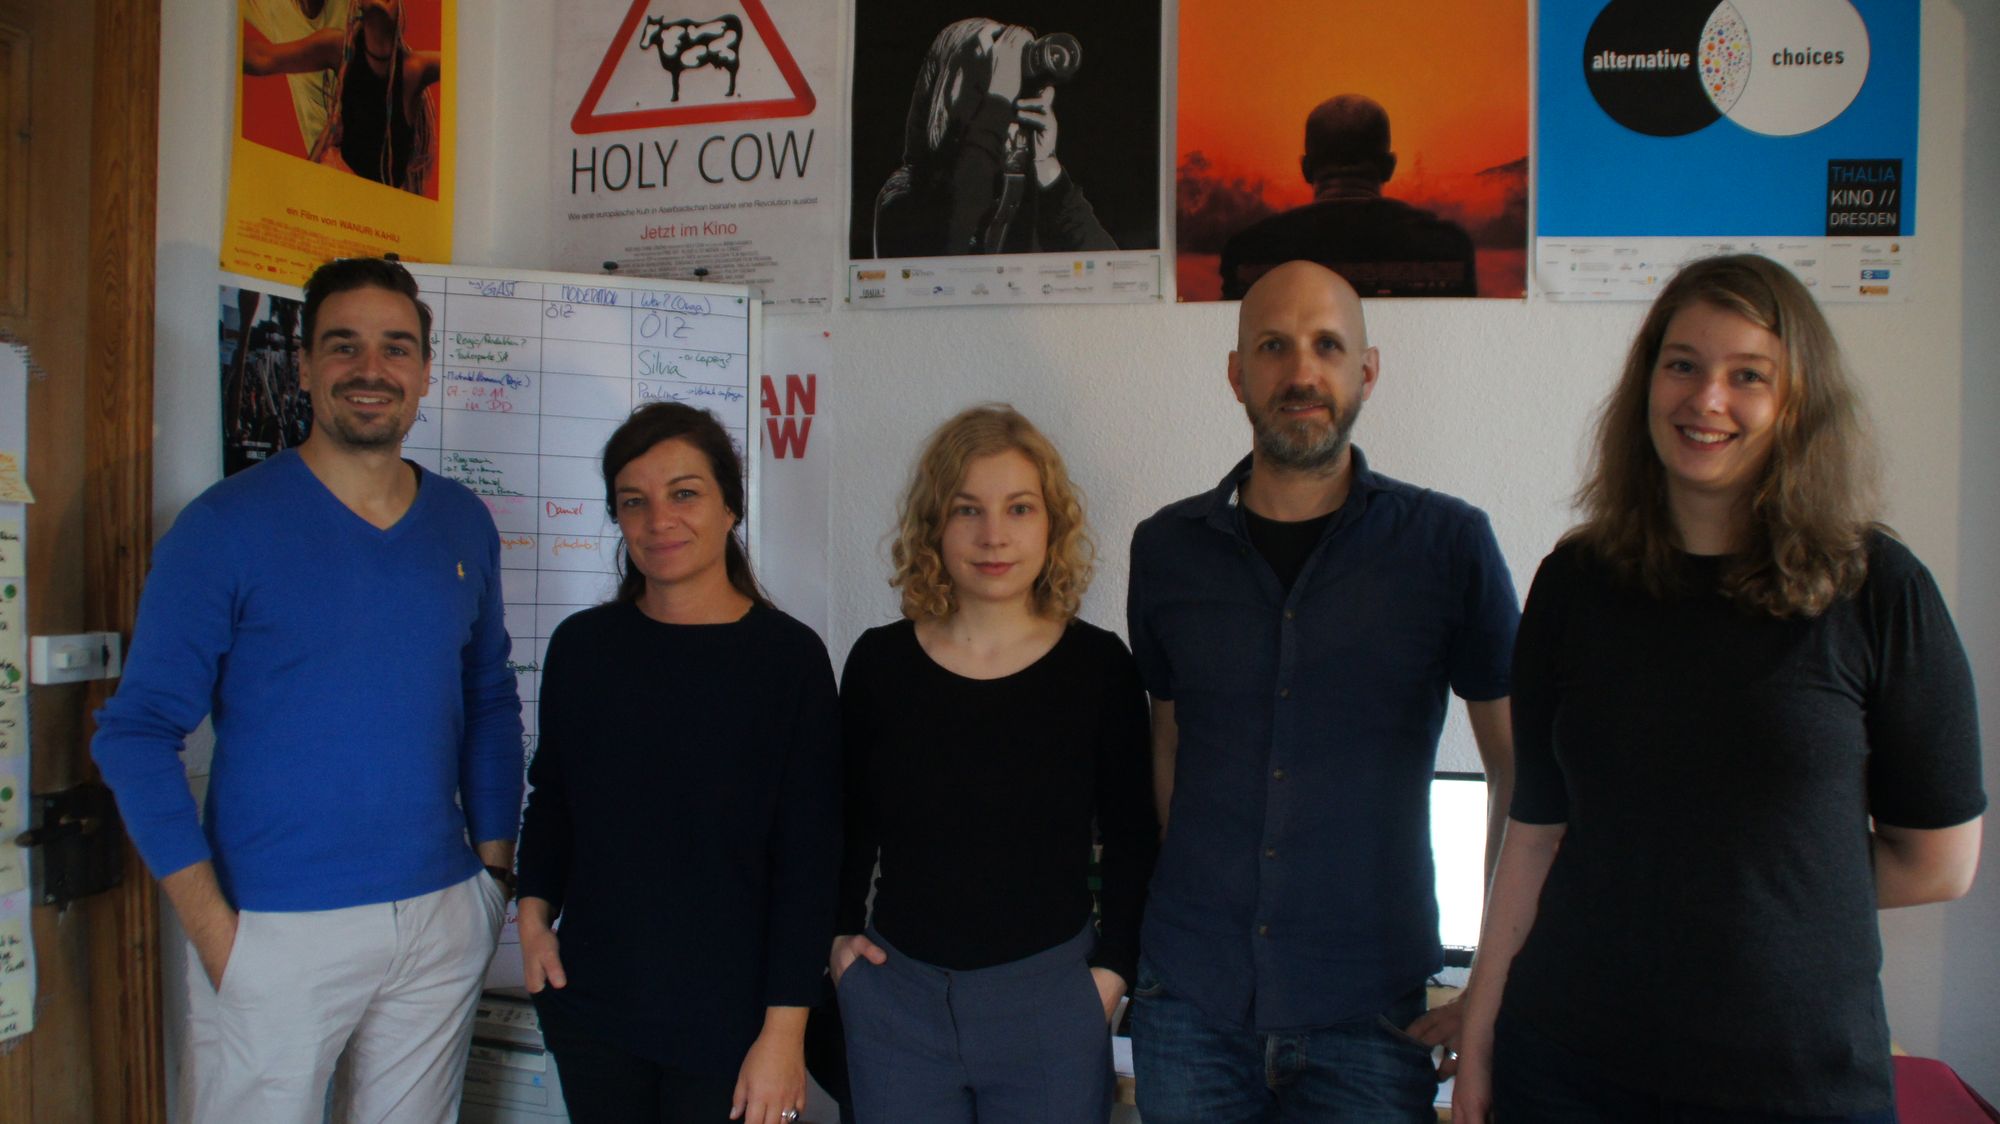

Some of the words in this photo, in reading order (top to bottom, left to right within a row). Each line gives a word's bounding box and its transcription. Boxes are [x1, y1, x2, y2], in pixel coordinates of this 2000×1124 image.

[1592, 48, 1691, 70] alternative
[1772, 47, 1845, 66] choices
[571, 139, 679, 194] HOLY
[698, 128, 815, 184] COW
[1831, 166, 1896, 182] THALIA
[753, 198, 791, 208] Revolution
[1831, 189, 1874, 206] KINO
[286, 207, 299, 216] ein
[300, 209, 319, 222] Film
[320, 217, 337, 226] von
[339, 219, 374, 237] WANURI
[1830, 212, 1897, 226] DRESDEN
[640, 223, 675, 240] Jetzt
[680, 223, 698, 237] im
[703, 221, 737, 237] Kino
[638, 349, 688, 379] Silvia
[637, 381, 690, 401] Pauline
